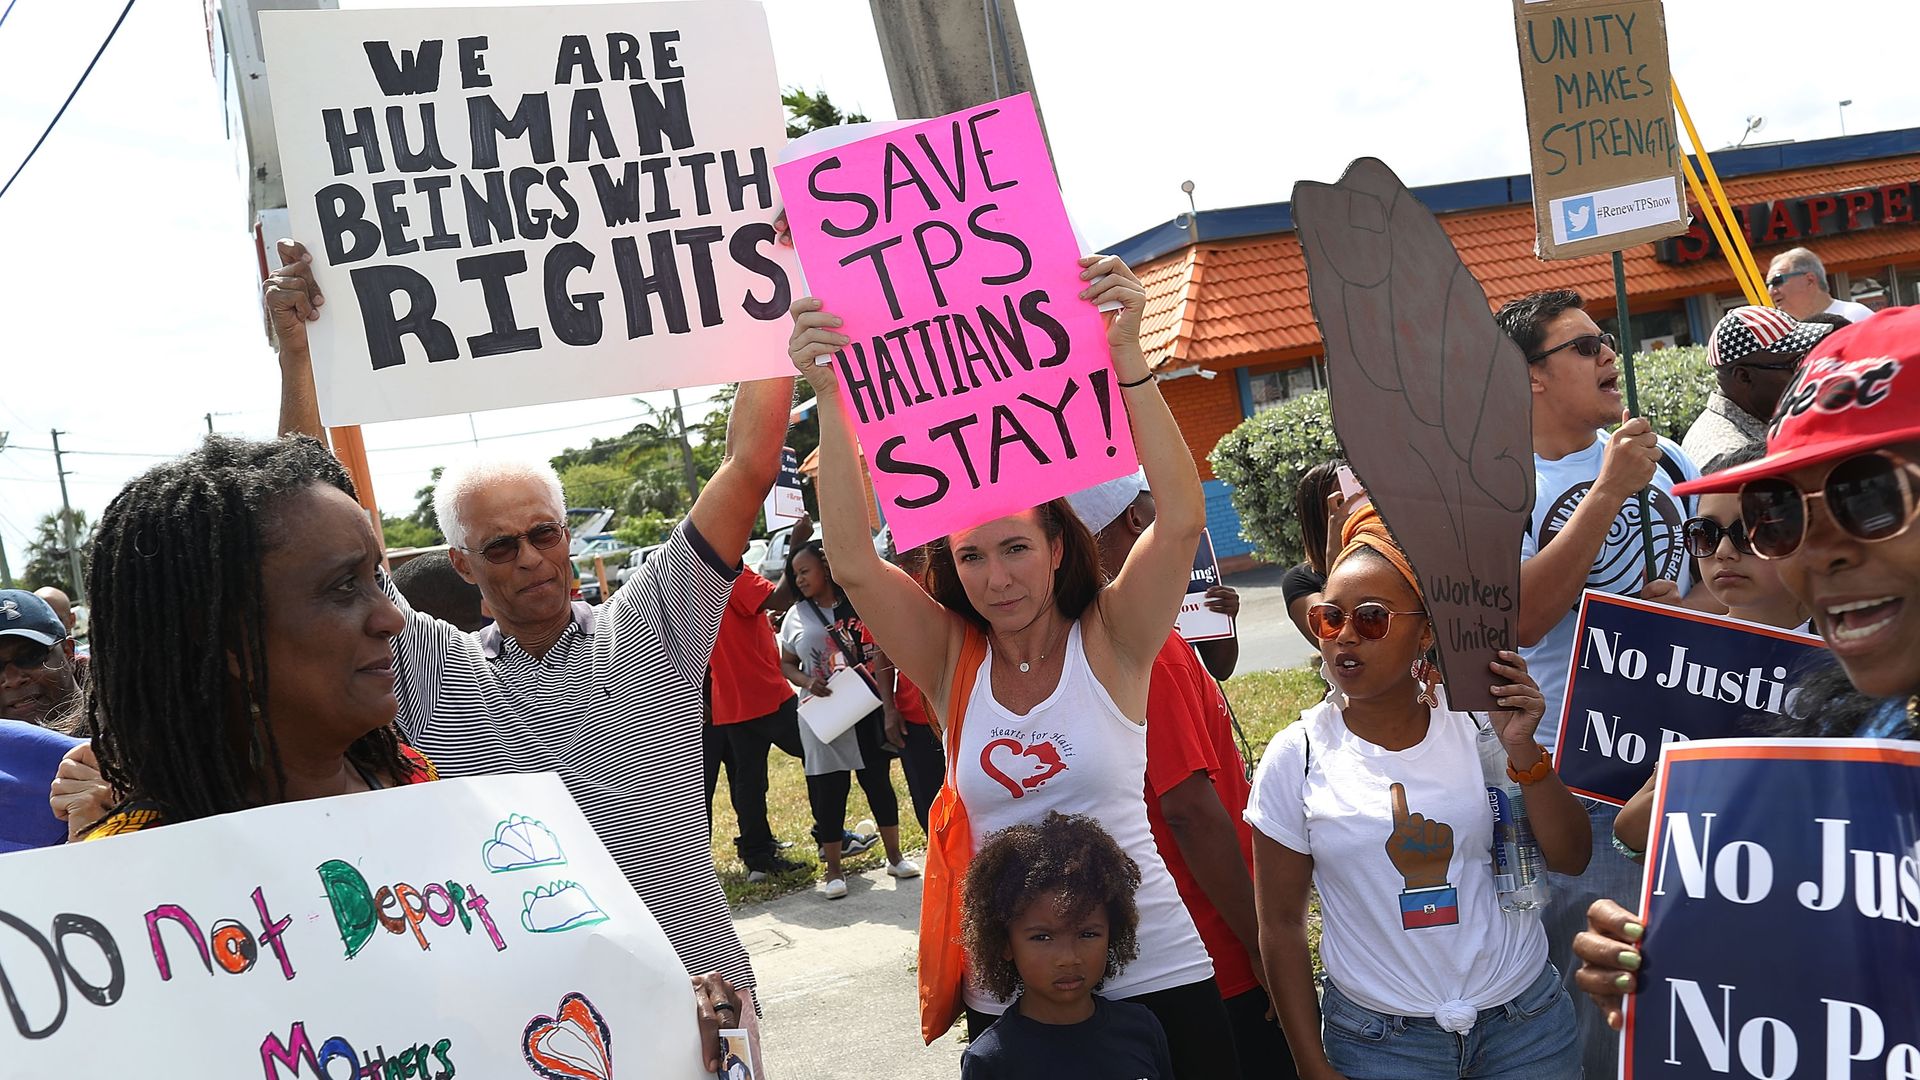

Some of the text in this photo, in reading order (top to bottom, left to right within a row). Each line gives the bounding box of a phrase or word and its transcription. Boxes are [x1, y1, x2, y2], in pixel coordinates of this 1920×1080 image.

[363, 30, 686, 96] WE ARE
[1528, 12, 1636, 64] UNITY
[321, 79, 695, 176] HUMAN
[1554, 64, 1654, 114] MAKES
[314, 147, 773, 267] BEINGS WITH
[807, 108, 1019, 238] SAVE
[1597, 197, 1672, 218] #RenewTPSnow
[349, 223, 792, 371] RIGHTS
[838, 203, 1033, 320] TPS
[834, 290, 1071, 424] HAITIANS
[875, 368, 1118, 509] STAY!
[1430, 575, 1513, 612] Workers
[1448, 614, 1509, 653] United
[1581, 627, 1648, 680] No
[991, 726, 1077, 757] Hearts for Haiti
[1579, 709, 1647, 764] No
[1653, 812, 1775, 905] No
[1664, 977, 1799, 1080] No
